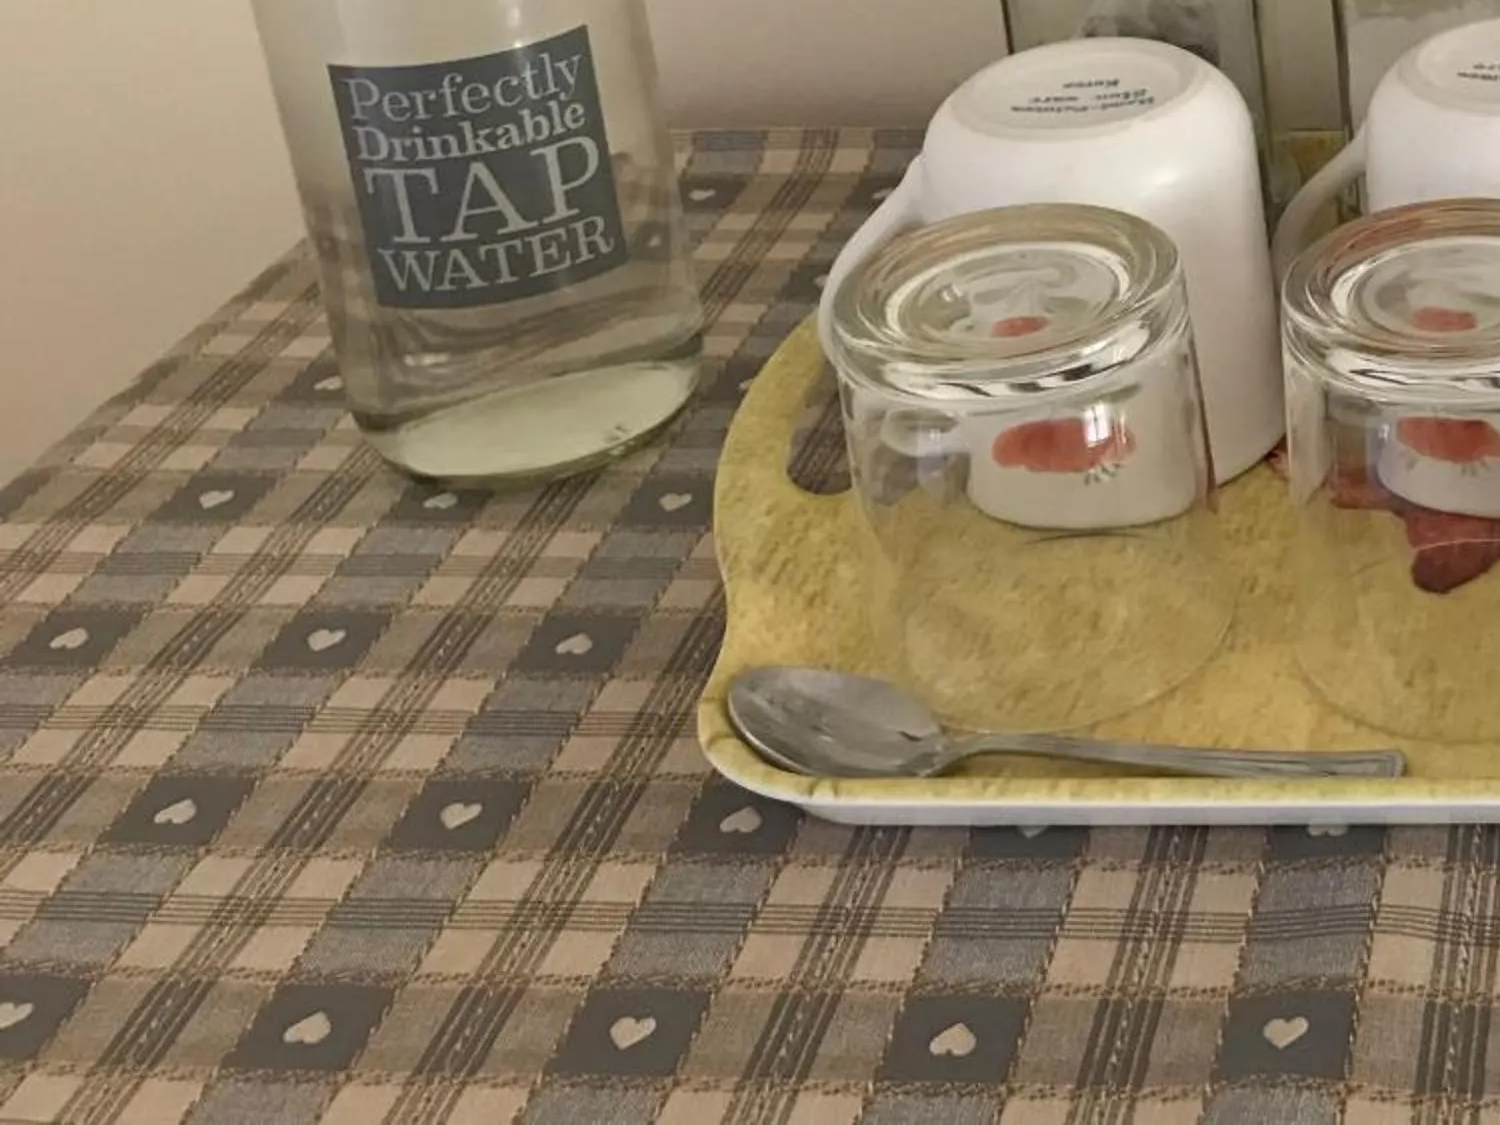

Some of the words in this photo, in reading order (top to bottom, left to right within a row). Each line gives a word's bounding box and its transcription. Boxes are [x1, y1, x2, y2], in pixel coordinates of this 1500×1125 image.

[342, 53, 582, 121] Perfectly
[353, 102, 586, 161] Drinkable
[364, 136, 599, 243] TAP
[377, 216, 614, 291] WATER
